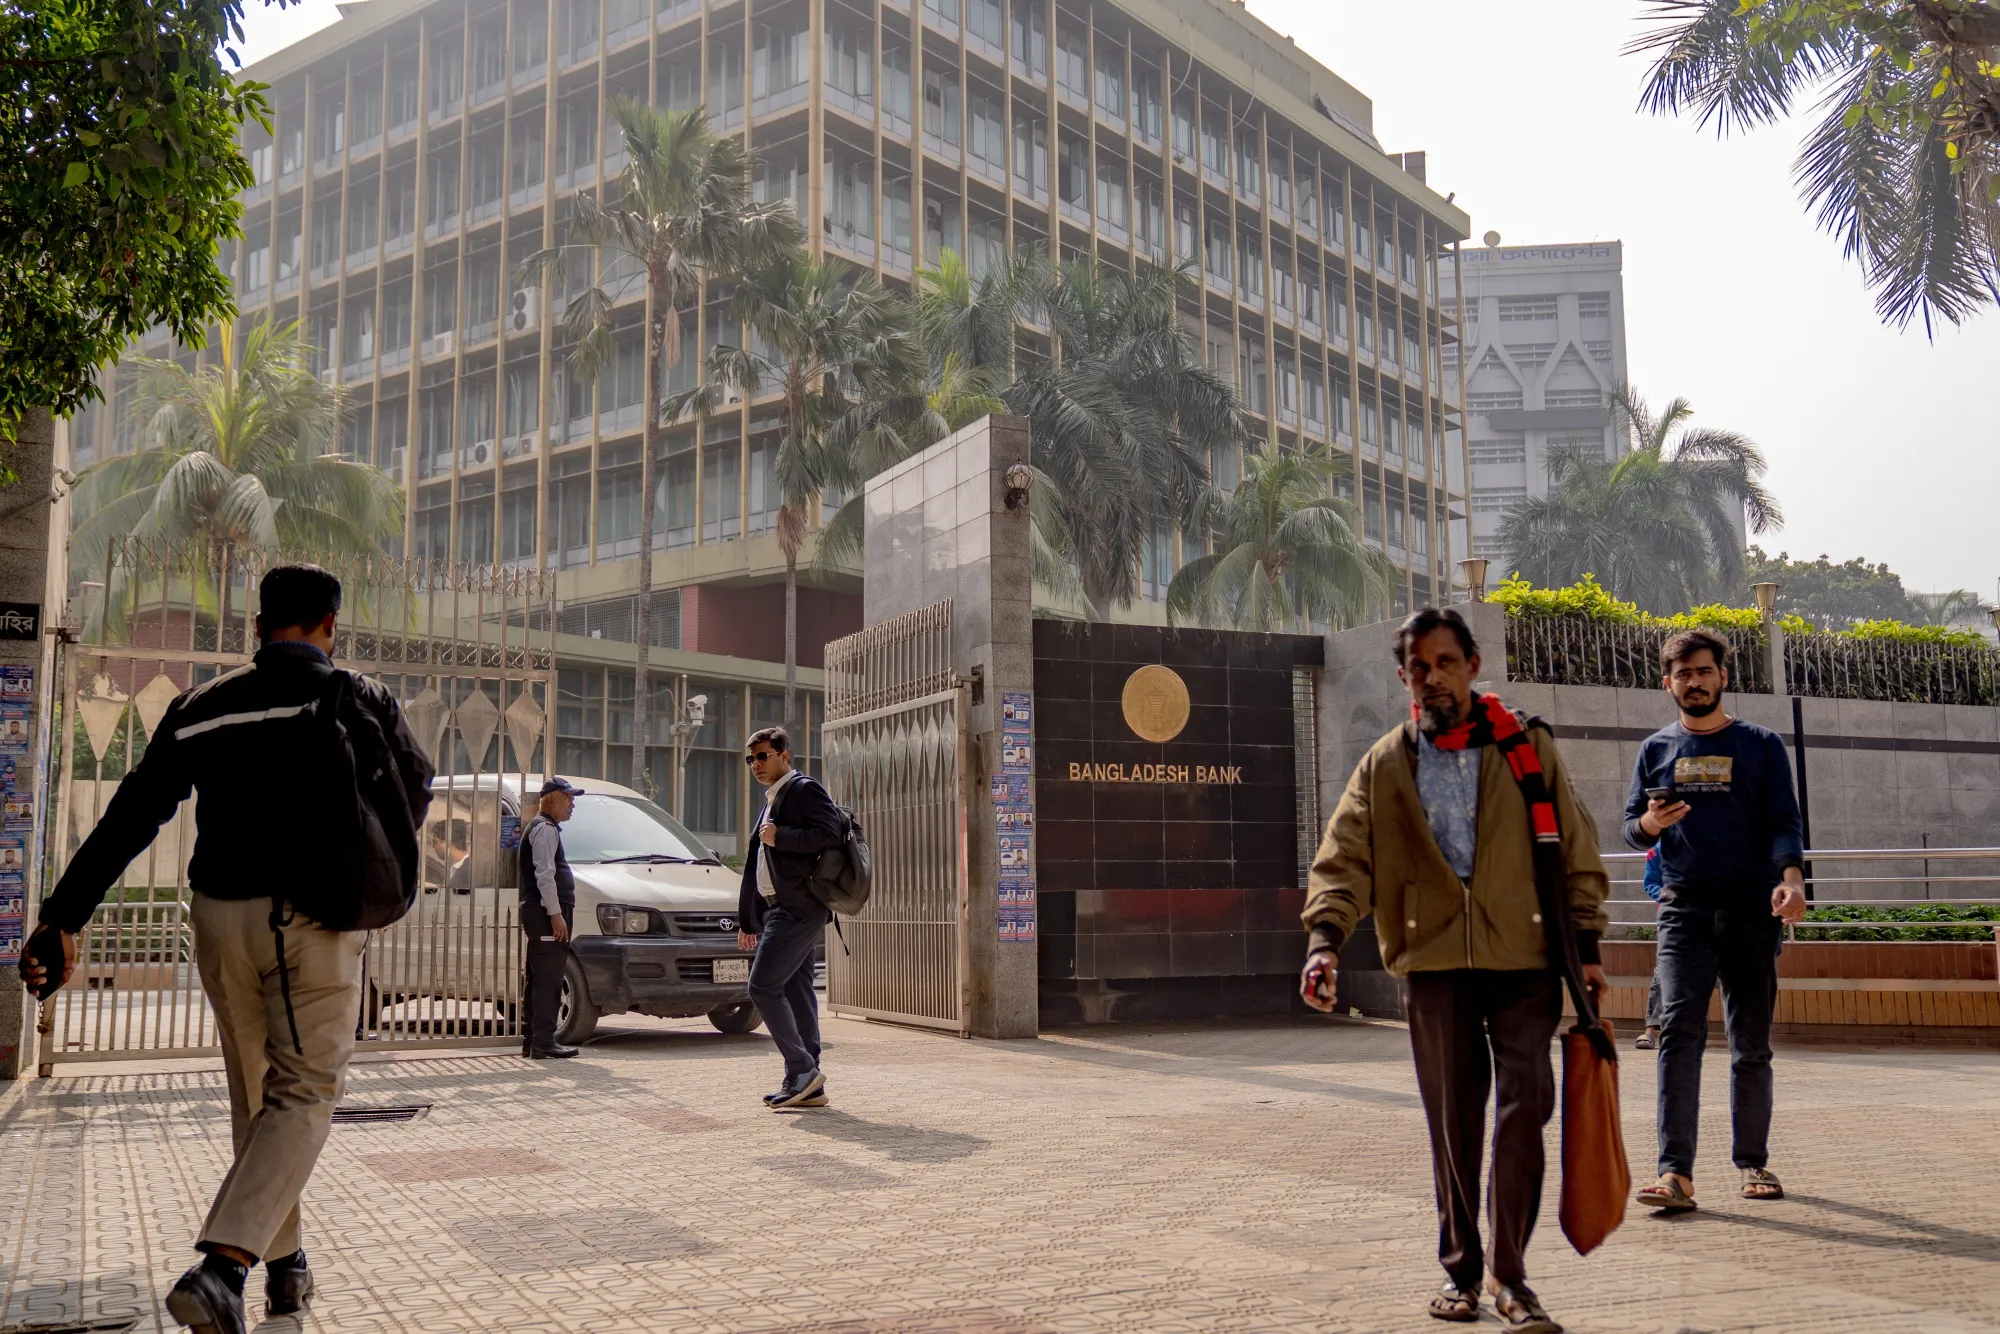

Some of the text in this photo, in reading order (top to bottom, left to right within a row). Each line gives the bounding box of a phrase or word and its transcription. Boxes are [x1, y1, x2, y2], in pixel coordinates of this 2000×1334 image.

[0, 610, 35, 634] াহির
[1069, 762, 1242, 784] BANGLADESH BANK
